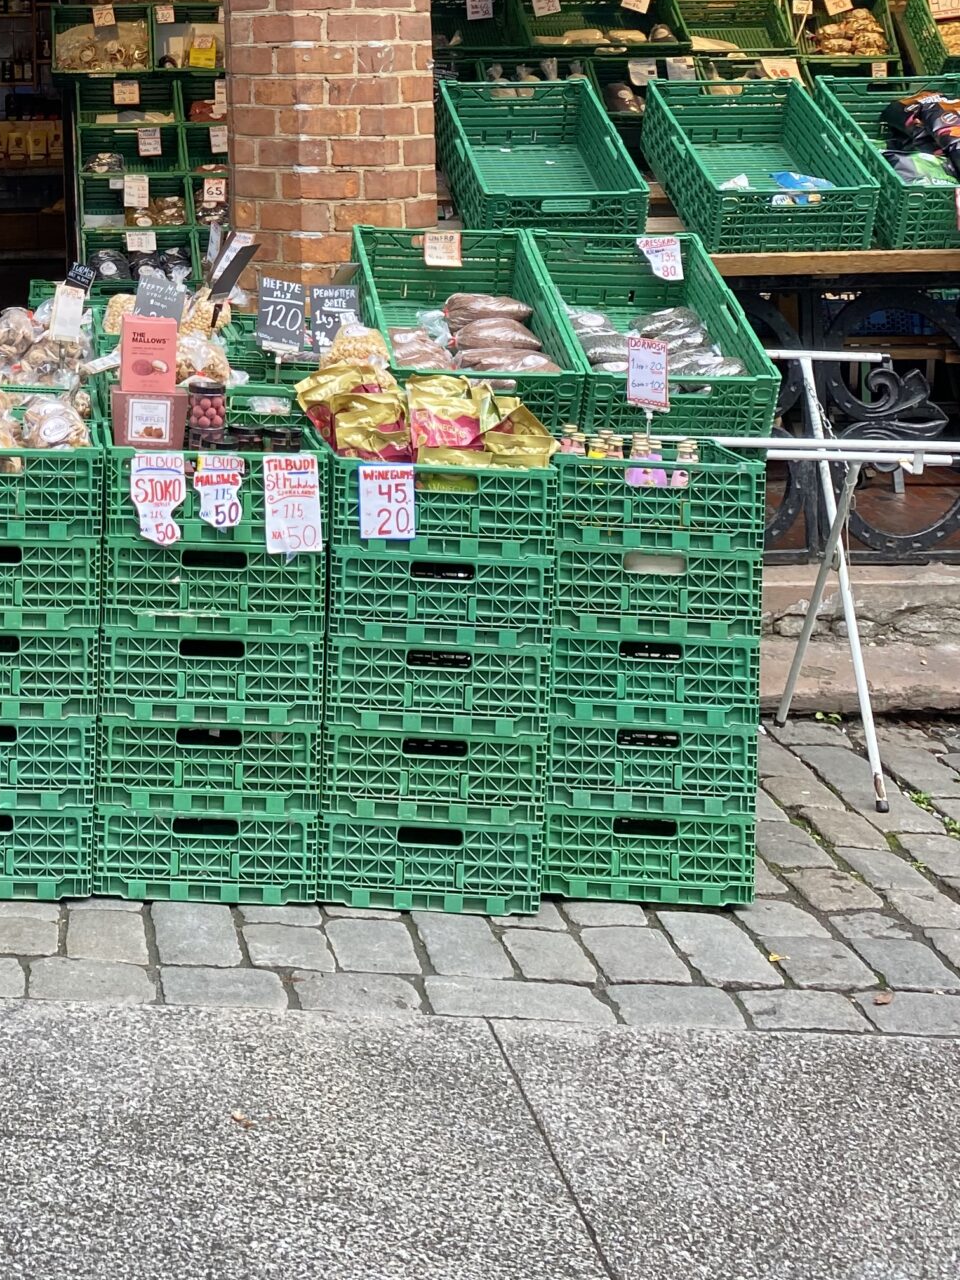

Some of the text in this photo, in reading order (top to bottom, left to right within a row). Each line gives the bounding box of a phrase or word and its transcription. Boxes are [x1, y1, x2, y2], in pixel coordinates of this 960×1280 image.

[263, 277, 302, 294] HEFTYE
[131, 337, 167, 345] MALLOWS
[136, 455, 183, 469] TILBUD
[134, 478, 182, 503] SJOKO
